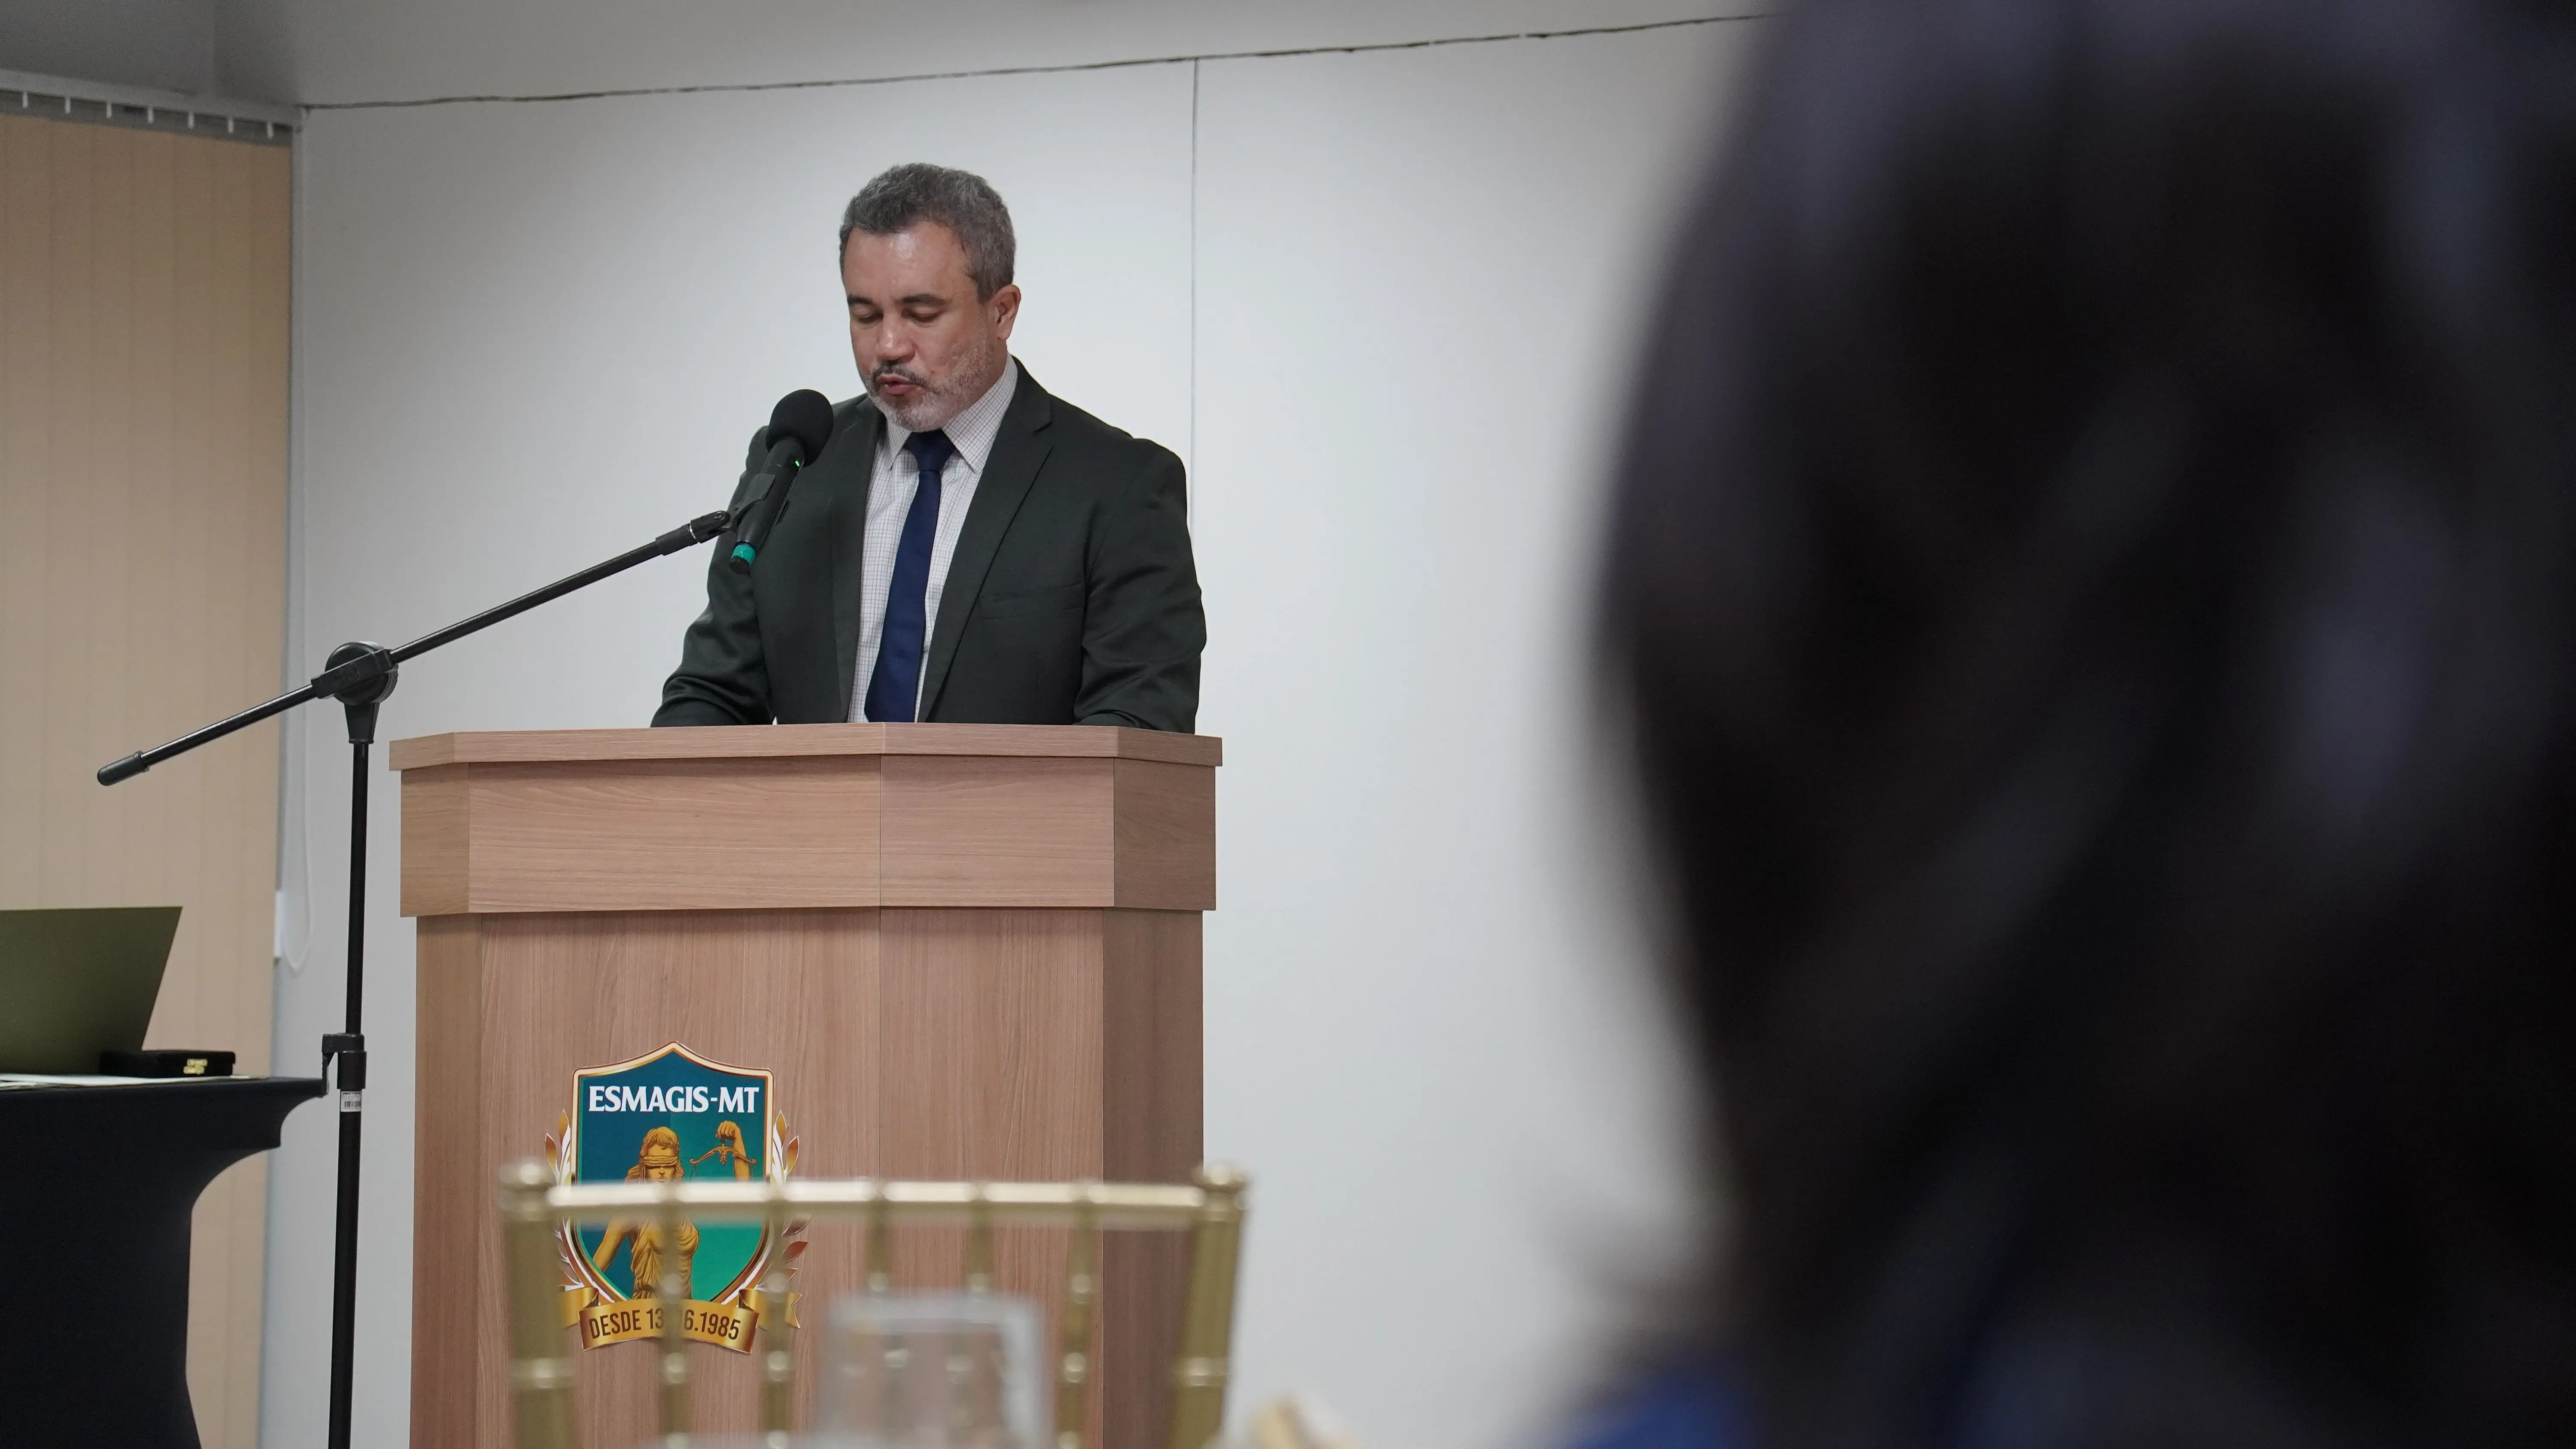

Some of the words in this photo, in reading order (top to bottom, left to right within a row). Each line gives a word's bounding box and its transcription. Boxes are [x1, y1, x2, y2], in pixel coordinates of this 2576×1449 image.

[588, 1085, 759, 1113] ESMAGIS-MT
[589, 1309, 641, 1339] DESDE
[646, 1308, 741, 1340] 136.1985
